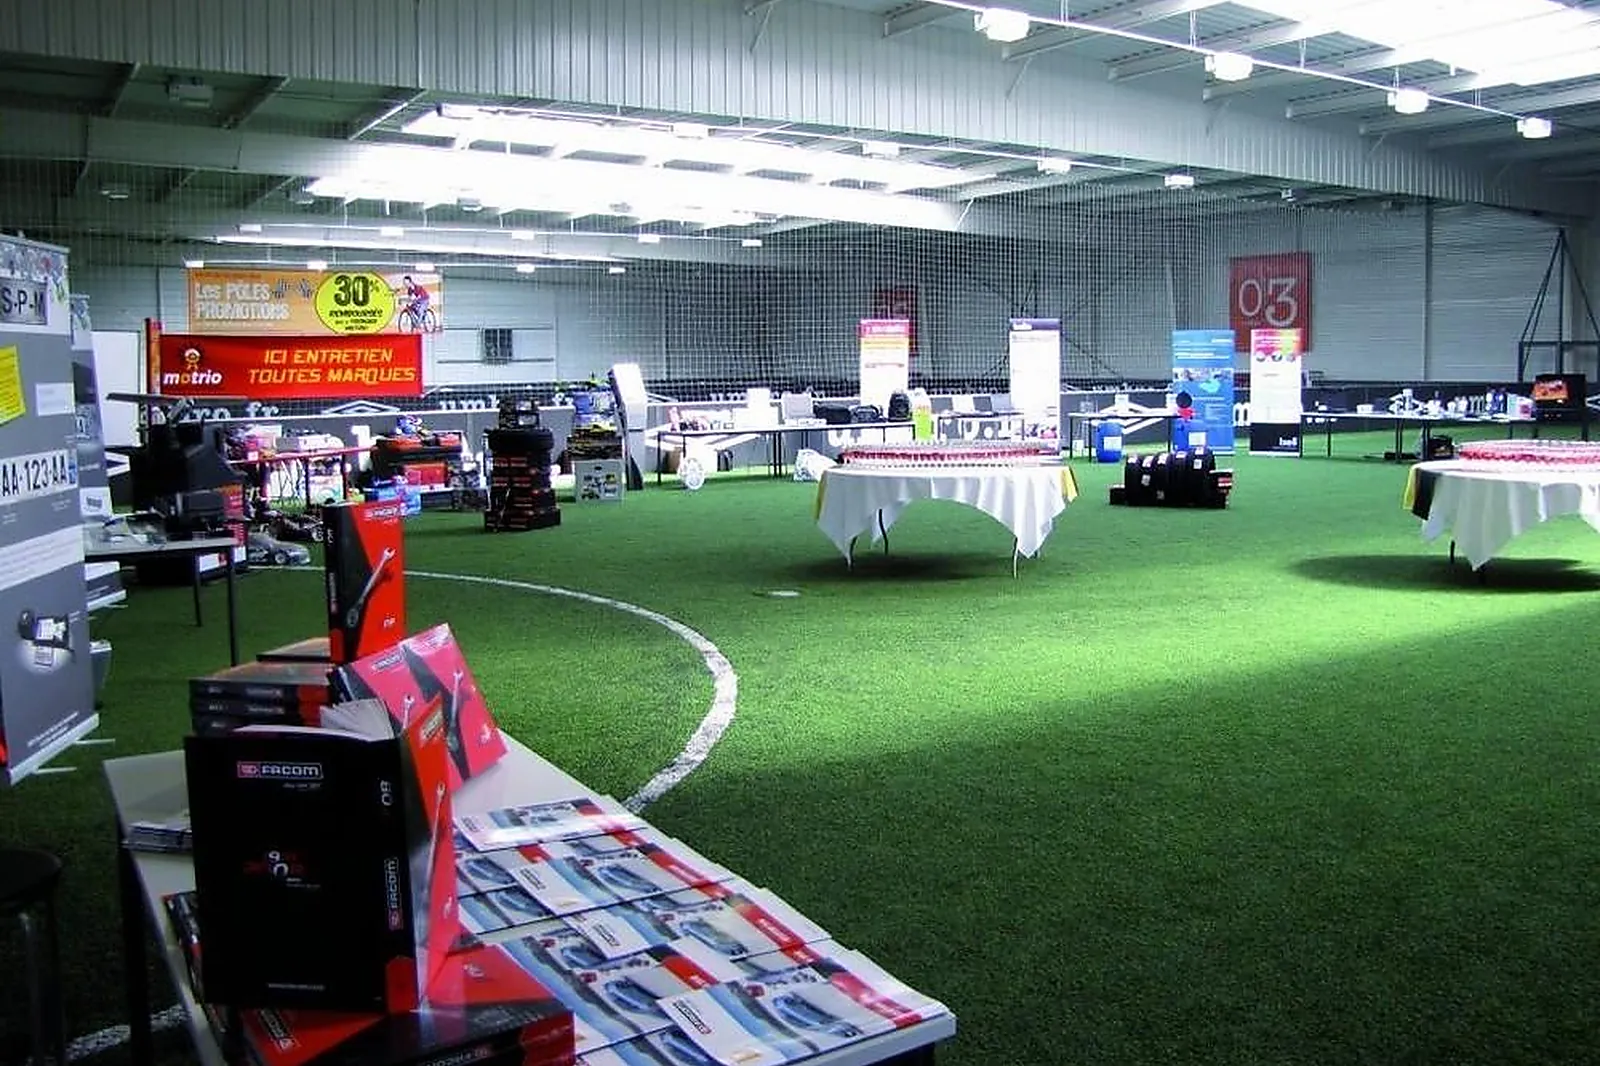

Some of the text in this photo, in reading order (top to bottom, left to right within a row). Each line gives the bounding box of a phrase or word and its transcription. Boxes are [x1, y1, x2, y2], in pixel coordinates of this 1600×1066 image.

[1239, 277, 1299, 327] 03
[195, 302, 289, 320] PROMOTIONS
[264, 348, 393, 364] ICI ENTRETIEN
[163, 369, 222, 386] motrio
[250, 367, 416, 386] TOUTES MARQUES
[262, 764, 319, 776] FACOM
